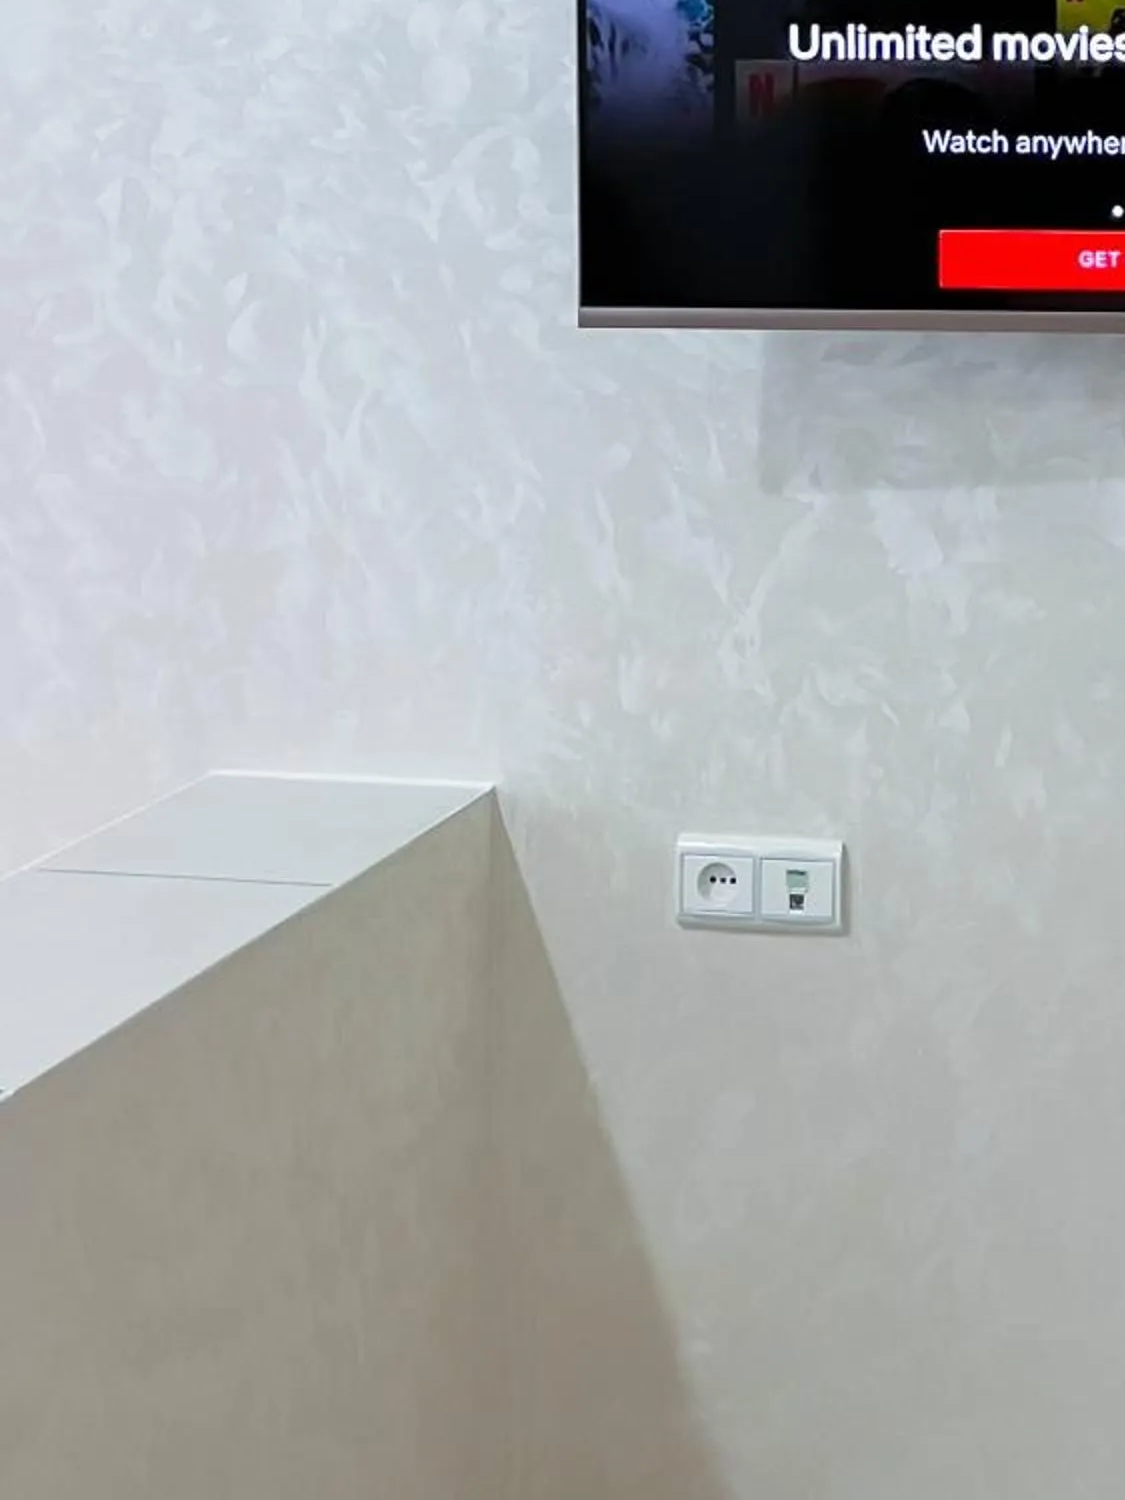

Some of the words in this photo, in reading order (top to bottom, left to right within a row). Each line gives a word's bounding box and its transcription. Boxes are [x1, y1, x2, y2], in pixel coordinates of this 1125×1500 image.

[789, 23, 982, 61] Unlimited
[922, 129, 1008, 154] Watch
[1078, 250, 1120, 268] GET
